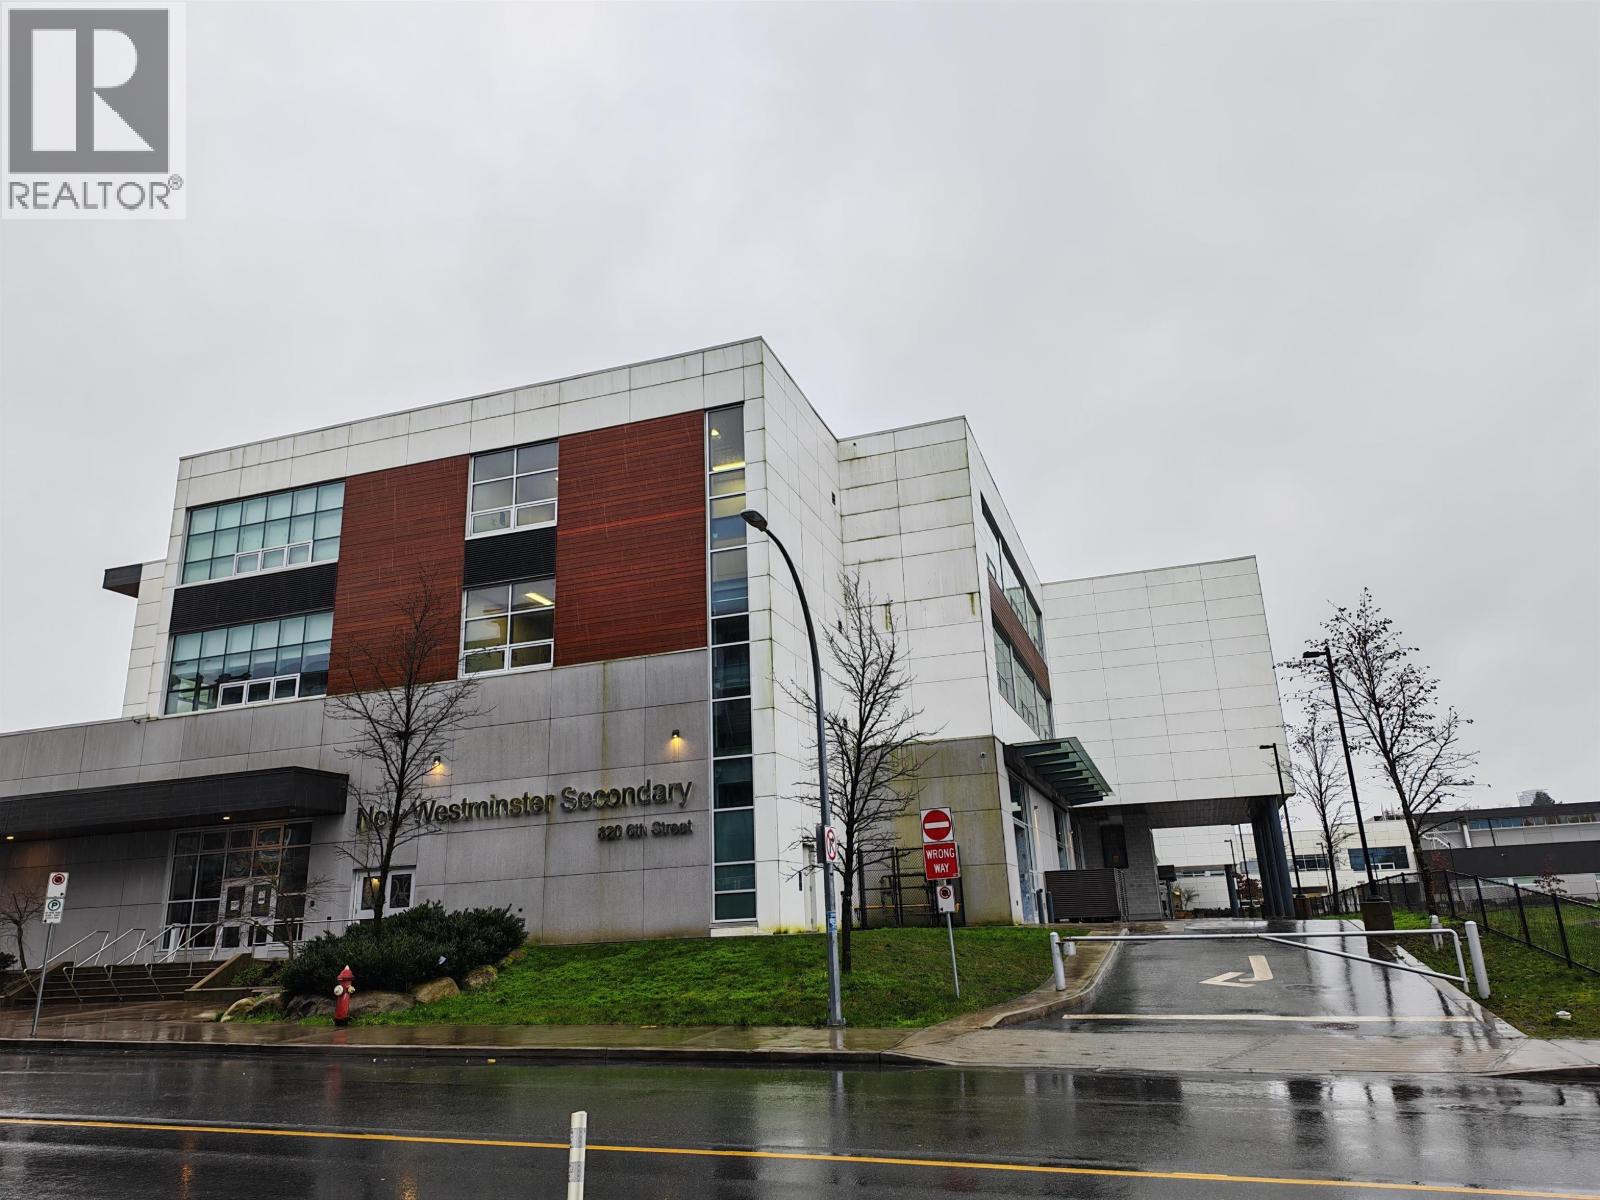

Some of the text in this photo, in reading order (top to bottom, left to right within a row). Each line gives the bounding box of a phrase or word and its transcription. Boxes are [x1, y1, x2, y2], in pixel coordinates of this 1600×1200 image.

[413, 793, 555, 825] Westminster
[560, 779, 693, 813] Secondary
[651, 819, 693, 837] Street
[926, 848, 955, 860] WRONG
[933, 863, 949, 874] WAY
